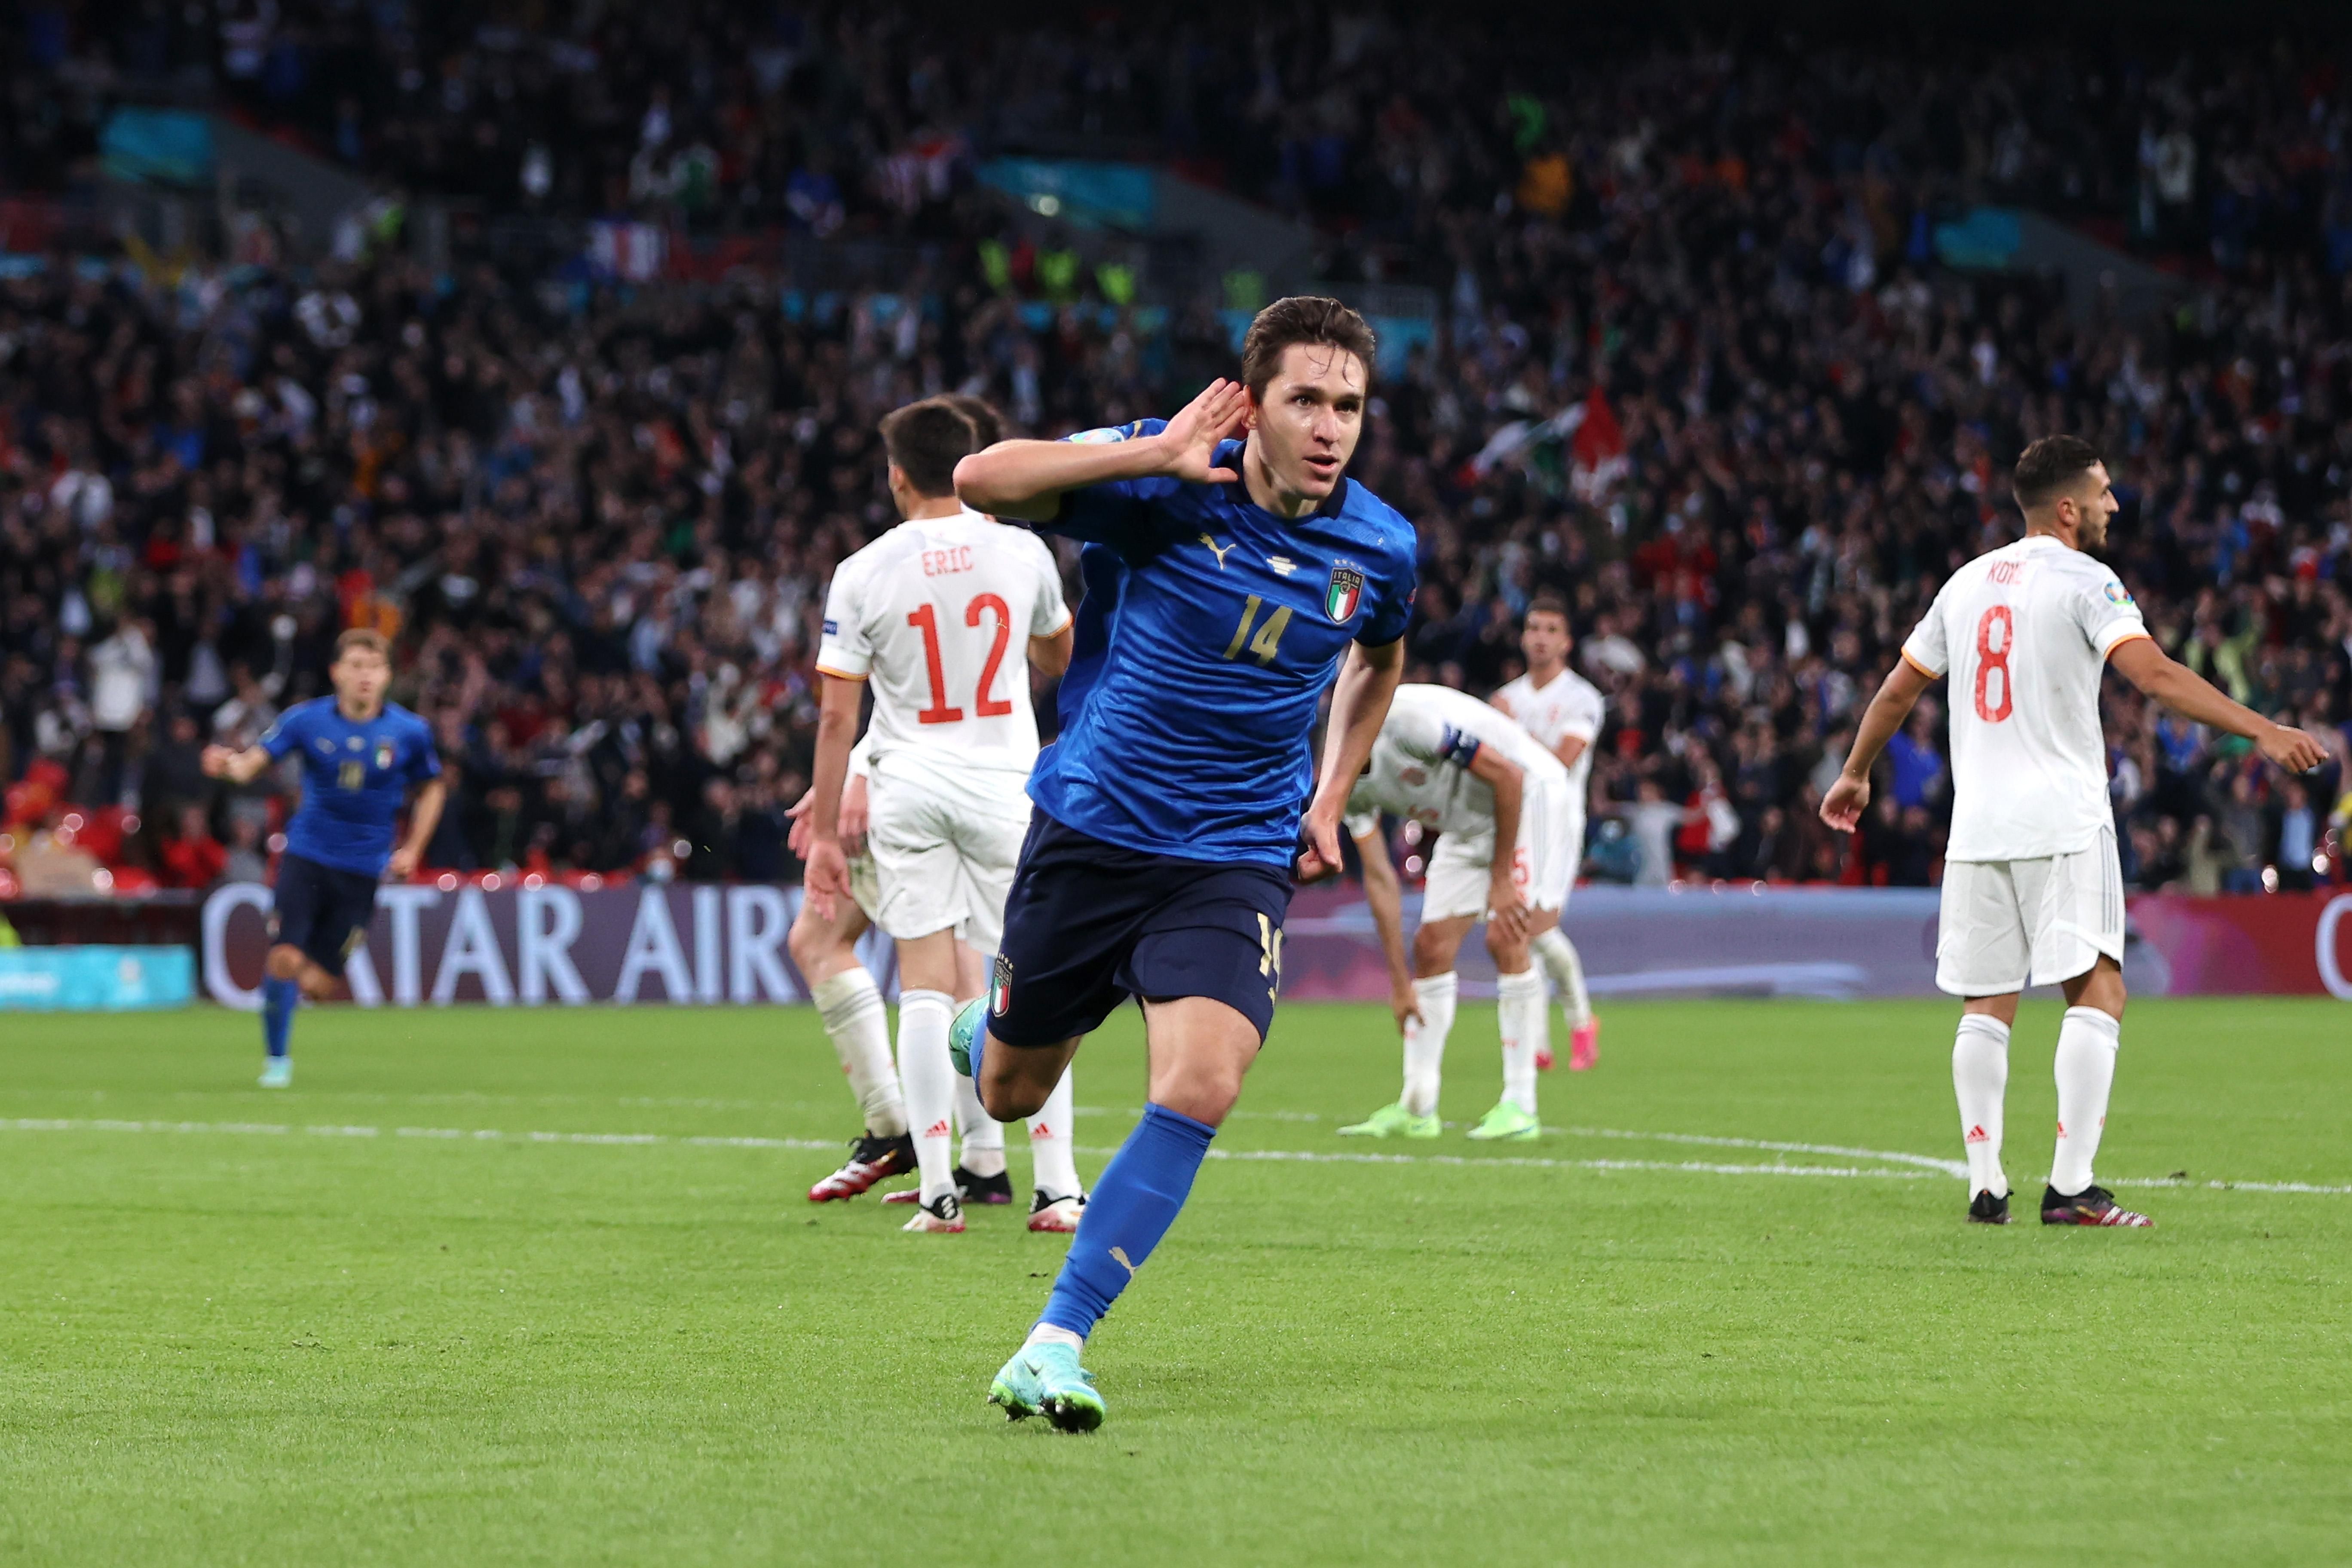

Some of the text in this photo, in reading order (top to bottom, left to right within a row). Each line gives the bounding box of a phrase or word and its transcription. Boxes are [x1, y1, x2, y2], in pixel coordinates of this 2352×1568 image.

[922, 545, 974, 577] ERIC
[1333, 571, 1360, 585] ITALIA
[907, 592, 1012, 723] 12
[1223, 594, 1292, 665] 14
[1975, 604, 2012, 723] 8
[200, 882, 897, 1008] QTAR AIR
